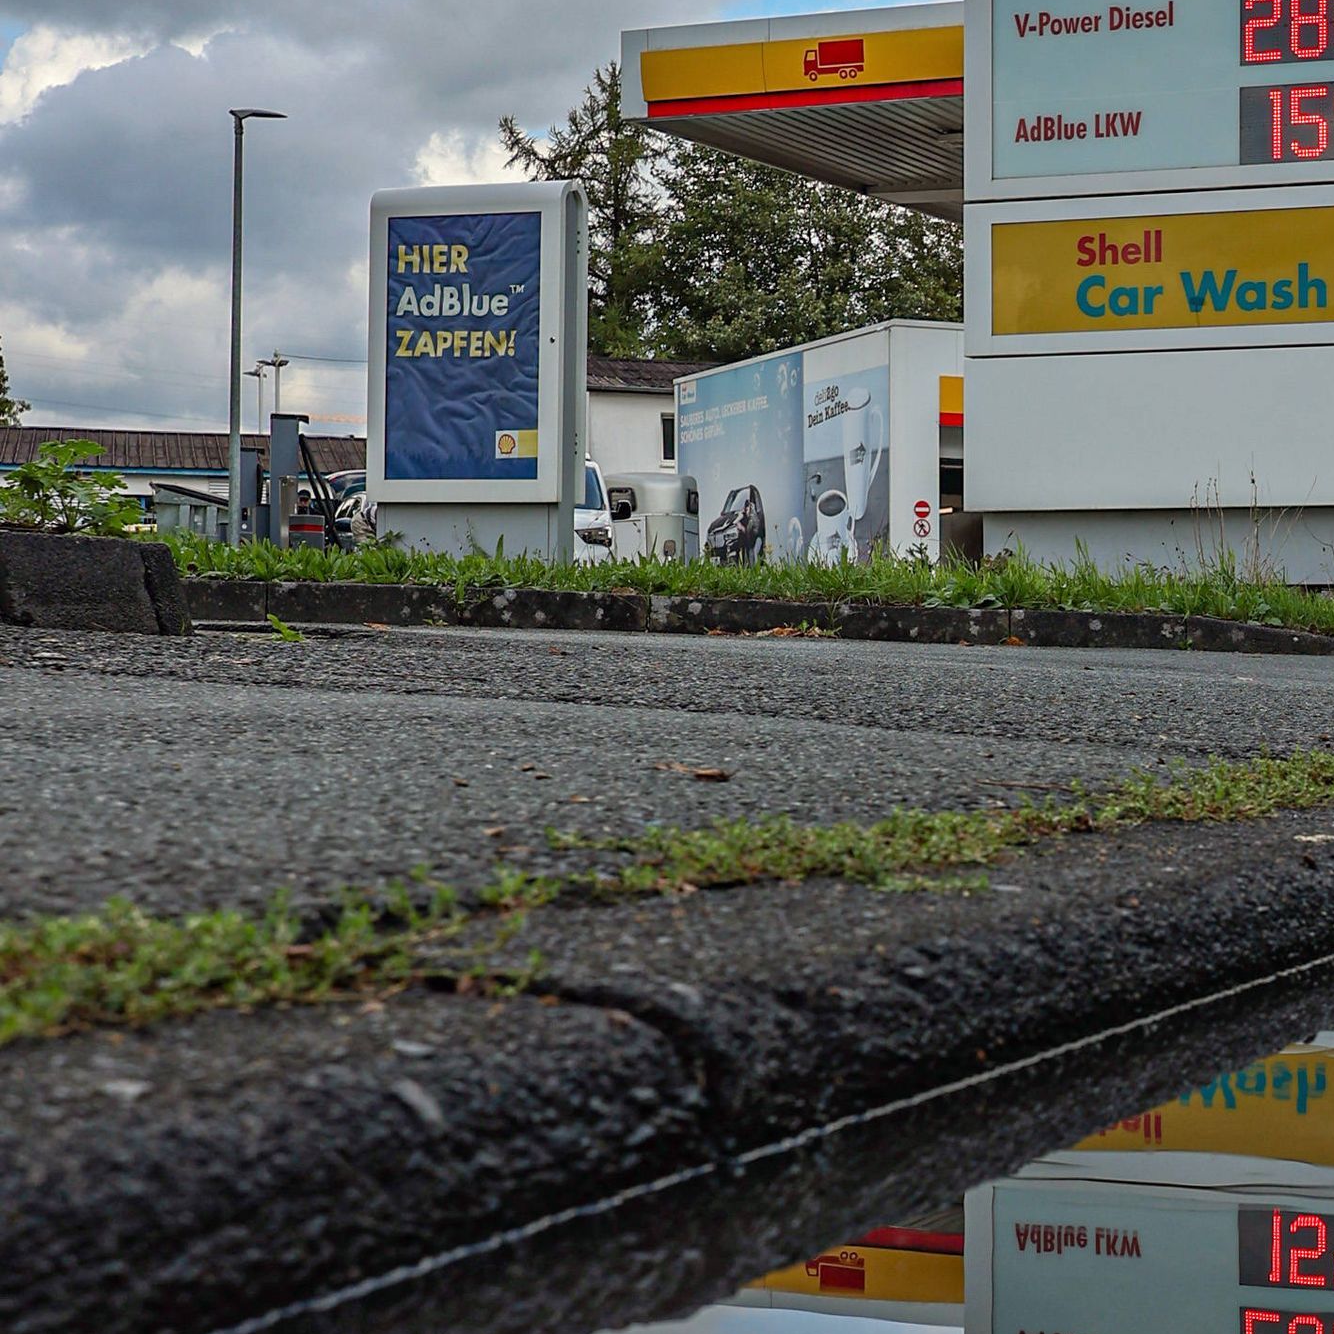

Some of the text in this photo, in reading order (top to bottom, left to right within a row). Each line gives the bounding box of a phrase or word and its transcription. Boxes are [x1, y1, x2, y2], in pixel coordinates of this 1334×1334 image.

[1014, 1, 1174, 38] V-Power Diesel
[1014, 111, 1142, 143] AdBlue LKW
[397, 244, 469, 274] HIER
[1076, 230, 1163, 268] Shell
[1076, 262, 1328, 318] Car Wash
[395, 330, 518, 358] ZAPFEN!
[807, 410, 824, 429] Dein
